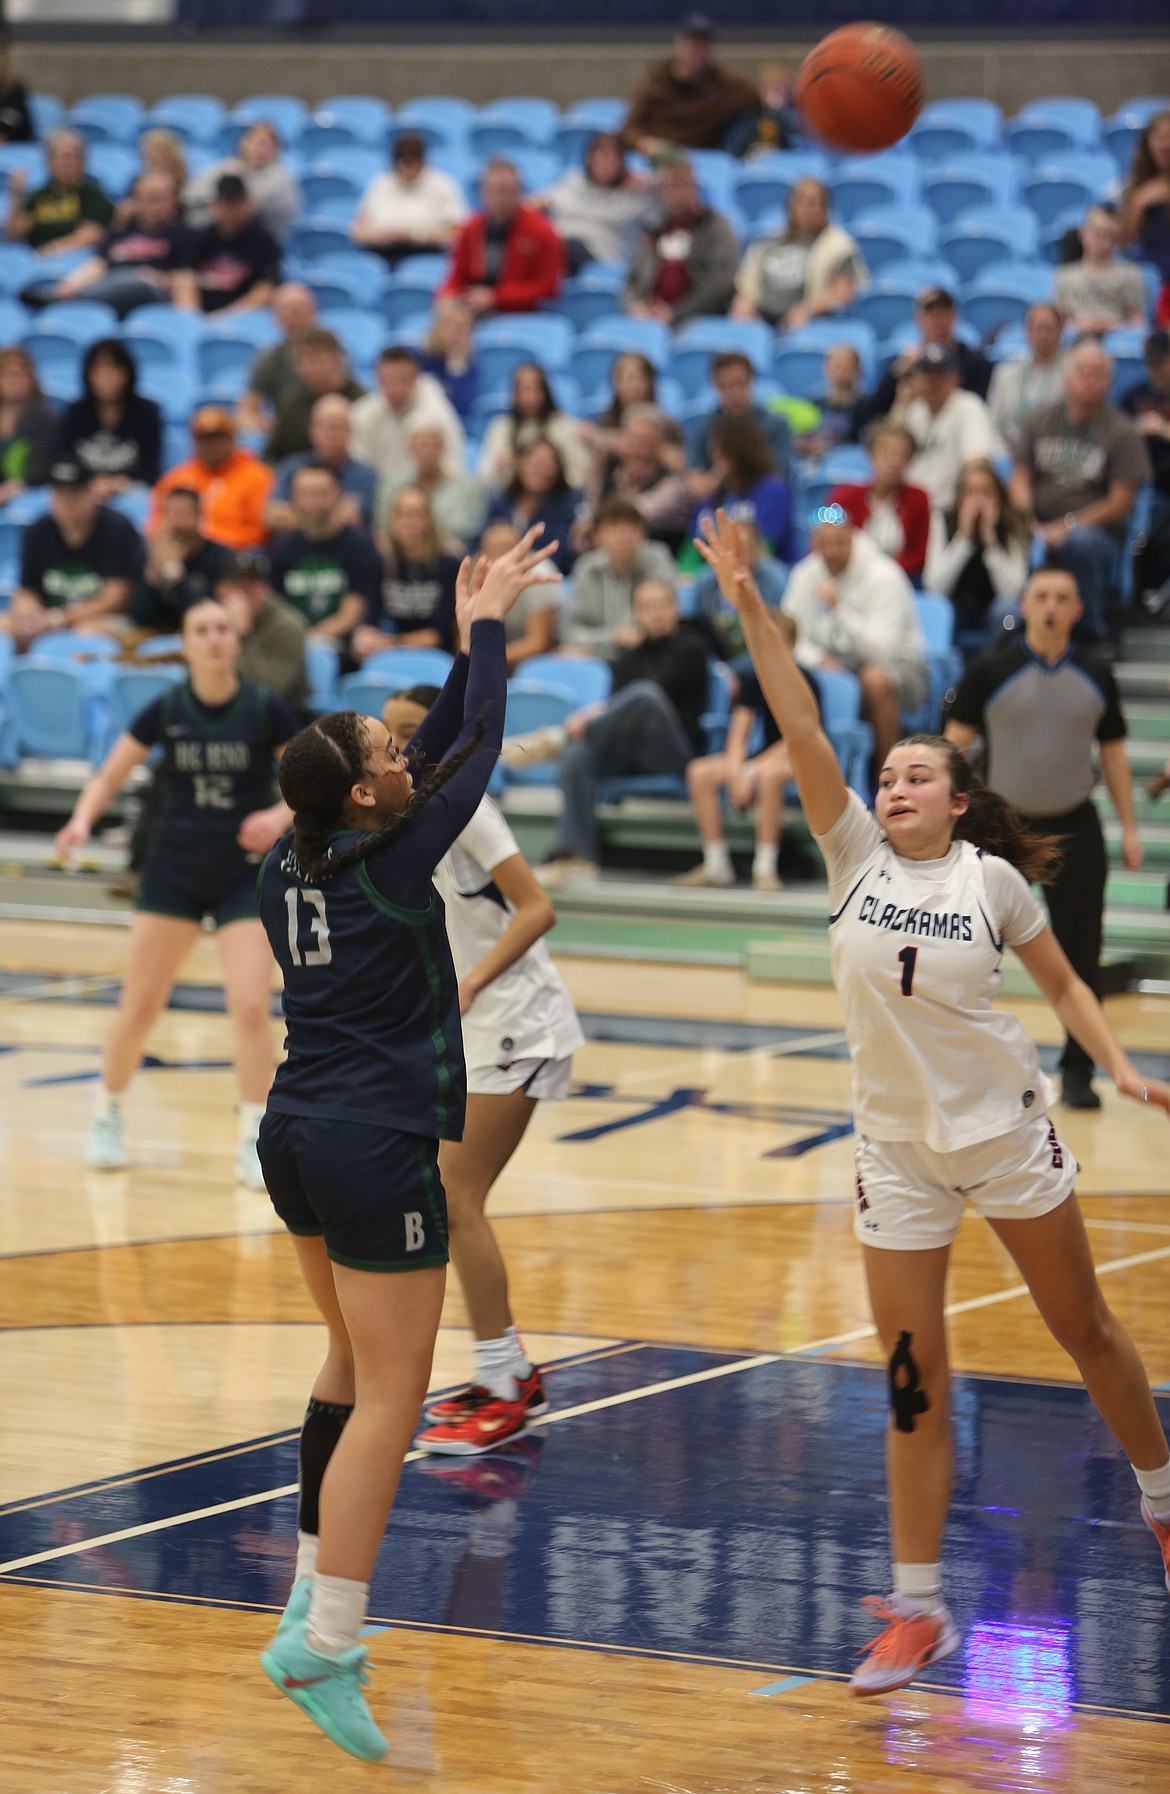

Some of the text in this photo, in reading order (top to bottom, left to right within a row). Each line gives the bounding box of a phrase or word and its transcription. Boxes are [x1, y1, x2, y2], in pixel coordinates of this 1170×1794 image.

[192, 774, 235, 810] 12
[284, 886, 332, 967] 13
[858, 894, 972, 942] CLACKAMAS
[897, 945, 919, 997] 1
[403, 1210, 426, 1252] B
